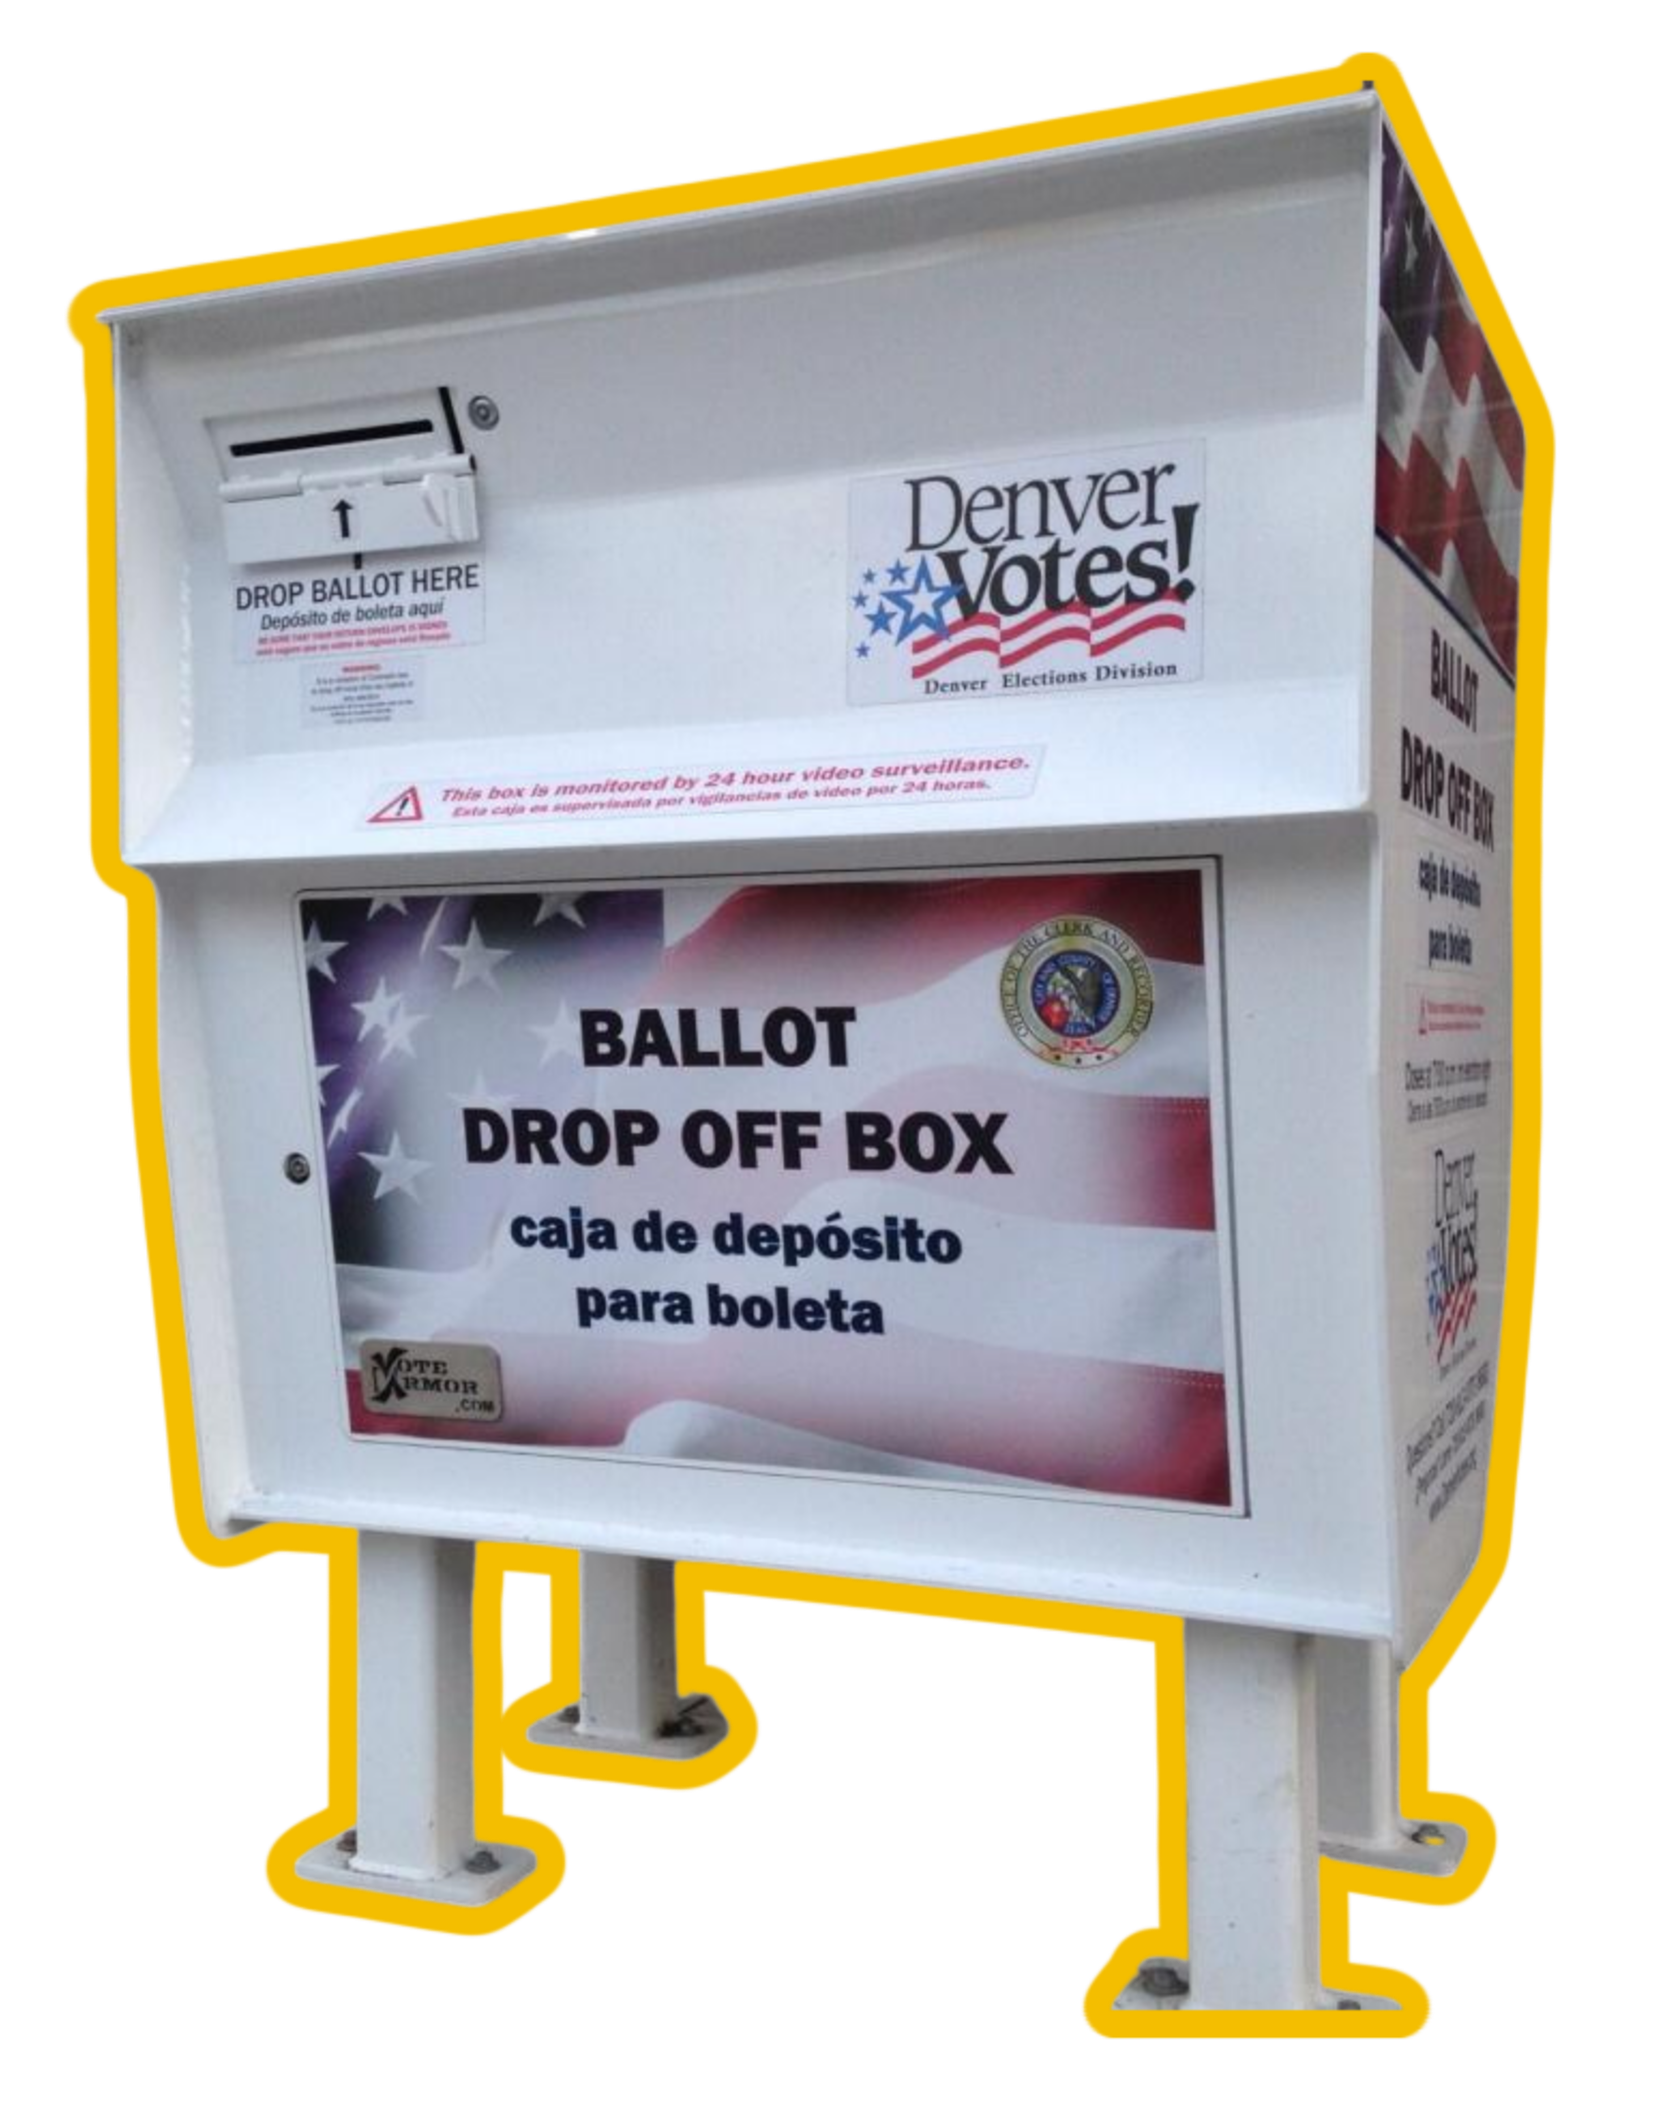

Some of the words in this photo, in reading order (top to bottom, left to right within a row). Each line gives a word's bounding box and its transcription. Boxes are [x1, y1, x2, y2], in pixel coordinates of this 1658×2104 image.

[904, 463, 1176, 552] Denver
[236, 581, 303, 610] DROP
[312, 572, 404, 604] BALLOT
[412, 564, 479, 593] HERE
[935, 503, 1201, 622] Votes!
[260, 607, 328, 631] Depósito
[331, 608, 350, 624] de
[356, 600, 403, 622] boleta
[408, 597, 445, 619] aquí
[924, 677, 988, 695] Denver
[1002, 667, 1087, 690] Elections
[1095, 661, 1178, 681] Division
[1430, 627, 1478, 733] BALLOT
[441, 785, 482, 802] This
[488, 784, 524, 801] box
[531, 782, 549, 798] is
[555, 776, 669, 798] monitored
[674, 775, 699, 794] by
[703, 771, 735, 788] 24
[742, 770, 794, 787] hour
[802, 765, 864, 783] video
[871, 756, 1030, 780] surveillance.
[452, 805, 486, 818] Esta
[491, 802, 526, 818] caja
[530, 803, 548, 814] es
[553, 797, 652, 814] supervisada
[656, 795, 684, 810] por
[787, 787, 809, 800] de
[866, 782, 898, 799] por
[902, 780, 927, 793] 24
[1401, 726, 1445, 819] DROP
[1448, 761, 1472, 834] OFF
[1472, 779, 1495, 853] BOX
[579, 1006, 856, 1068] BALLOT
[462, 1107, 660, 1167] DROP
[681, 1109, 821, 1170] OFF
[845, 1111, 1014, 1175] BOX
[1434, 1148, 1475, 1228] Denver
[510, 1207, 617, 1259] caja
[632, 1210, 697, 1254] de
[713, 1211, 962, 1266] depósito
[577, 1285, 694, 1328] para
[706, 1283, 884, 1335] boleta
